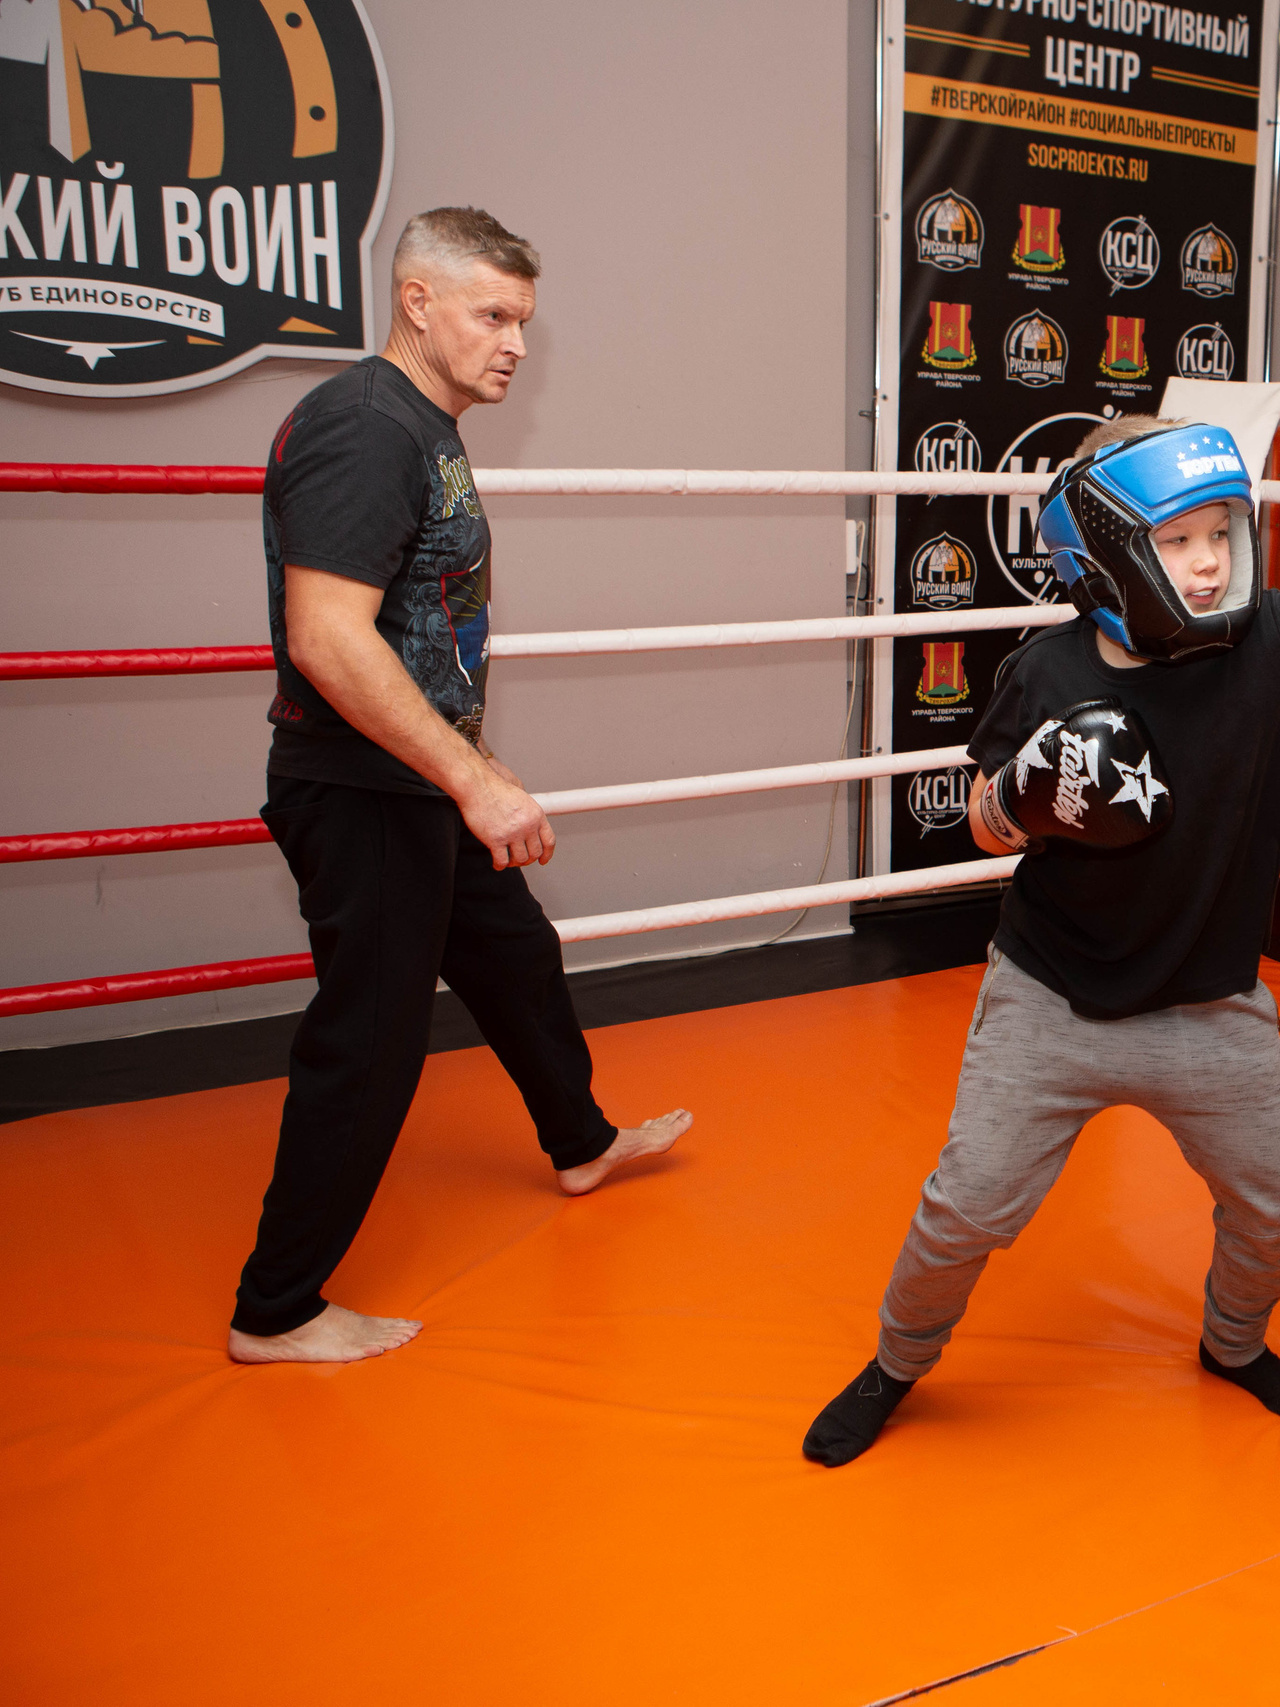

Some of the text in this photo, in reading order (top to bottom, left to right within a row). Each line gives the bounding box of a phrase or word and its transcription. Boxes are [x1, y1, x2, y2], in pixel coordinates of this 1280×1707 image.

[1045, 36, 1141, 93] ЦЕНТР
[931, 85, 1236, 154] #ТВЕРСКОЙРАЙОН #СОЦИАЛЬНЫЕПРОЕКТЫ
[1028, 143, 1149, 182] SOCPROEKTS.RU
[161, 180, 342, 310] ВОИН
[1106, 231, 1154, 275] КСЦ
[30, 286, 212, 323] ЕДИНОБОРСТВ
[1009, 355, 1041, 373] РУССКИЙ
[1183, 338, 1228, 381] КСЦ
[1012, 558, 1055, 569] КУЛЬТУР
[917, 580, 971, 598] РУССКИЙ ВОИН
[916, 774, 966, 812] КСЦ
[1052, 730, 1100, 829] Fairtex
